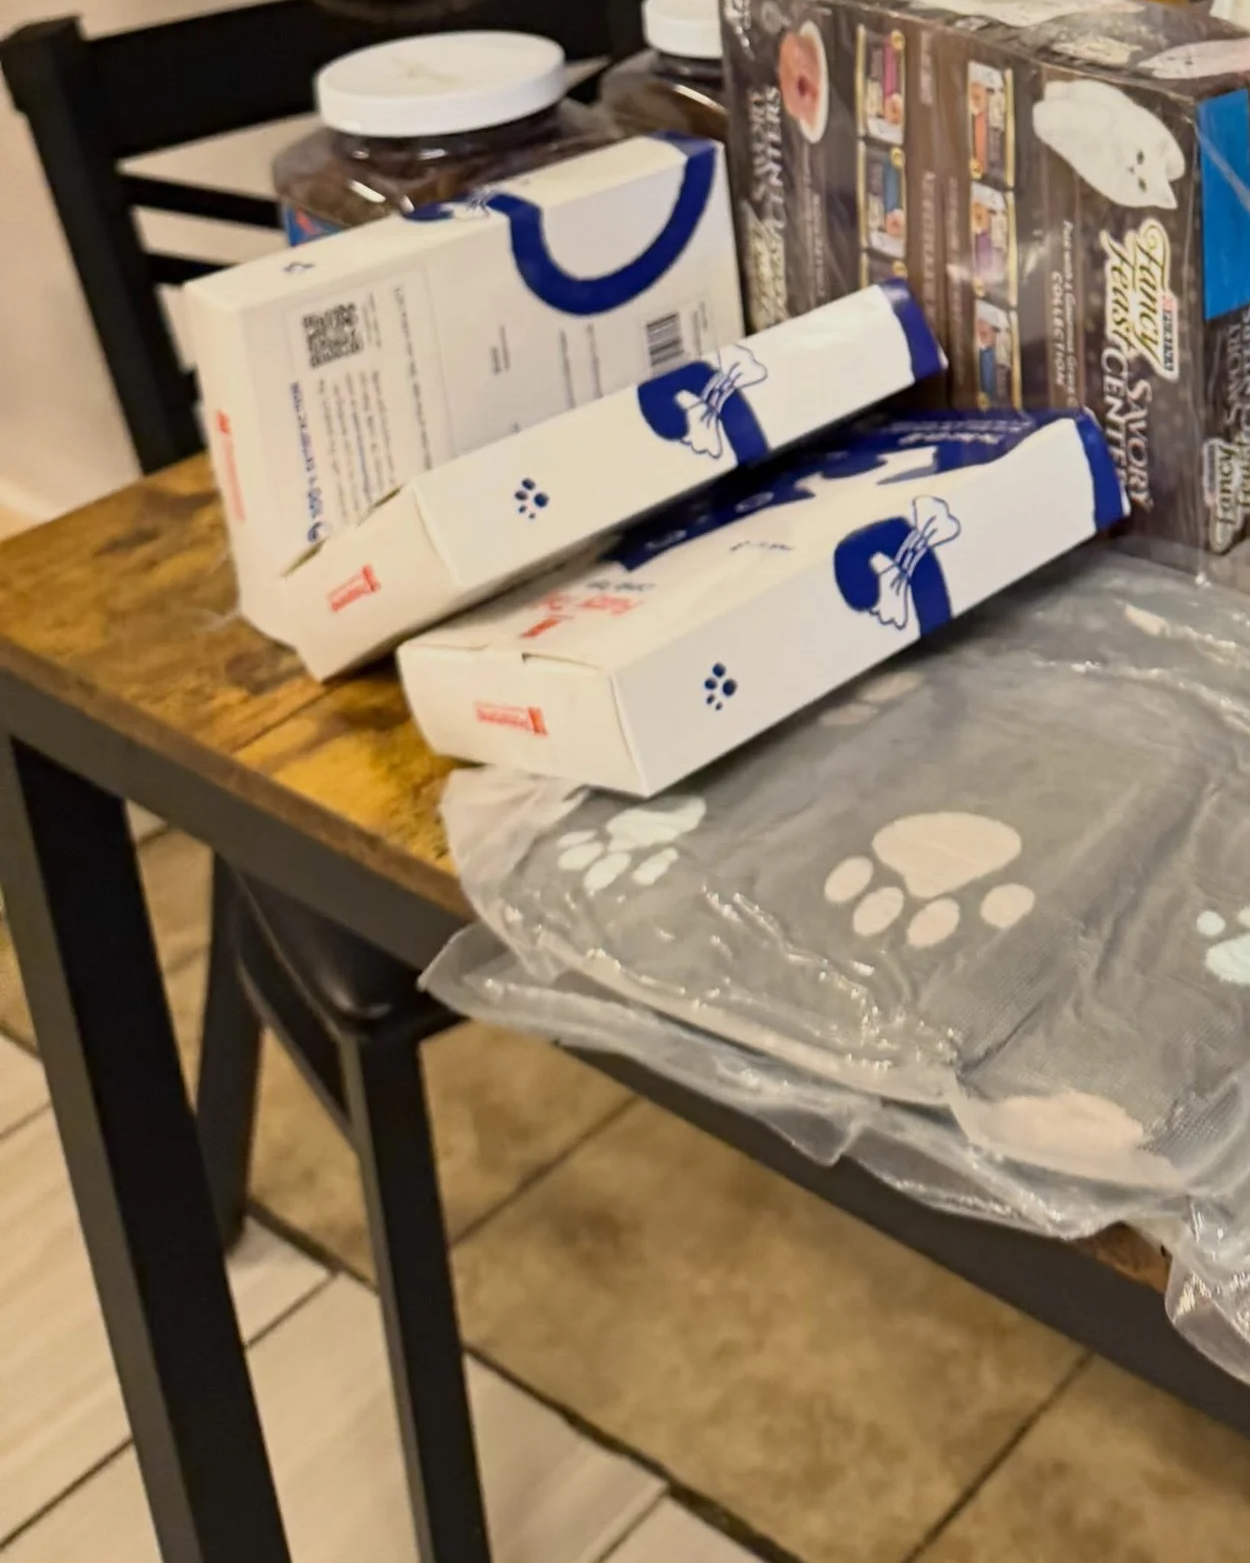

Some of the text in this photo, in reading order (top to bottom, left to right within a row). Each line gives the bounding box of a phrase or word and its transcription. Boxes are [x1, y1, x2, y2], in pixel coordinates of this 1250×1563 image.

[1052, 271, 1065, 386] COLLECTION
[1109, 237, 1136, 350] Feast
[1134, 225, 1167, 364] Fancy
[1101, 347, 1128, 484] CENTE
[1225, 324, 1243, 424] SAVORY
[1127, 380, 1153, 513] SAVORY
[1213, 445, 1236, 527] Fancy
